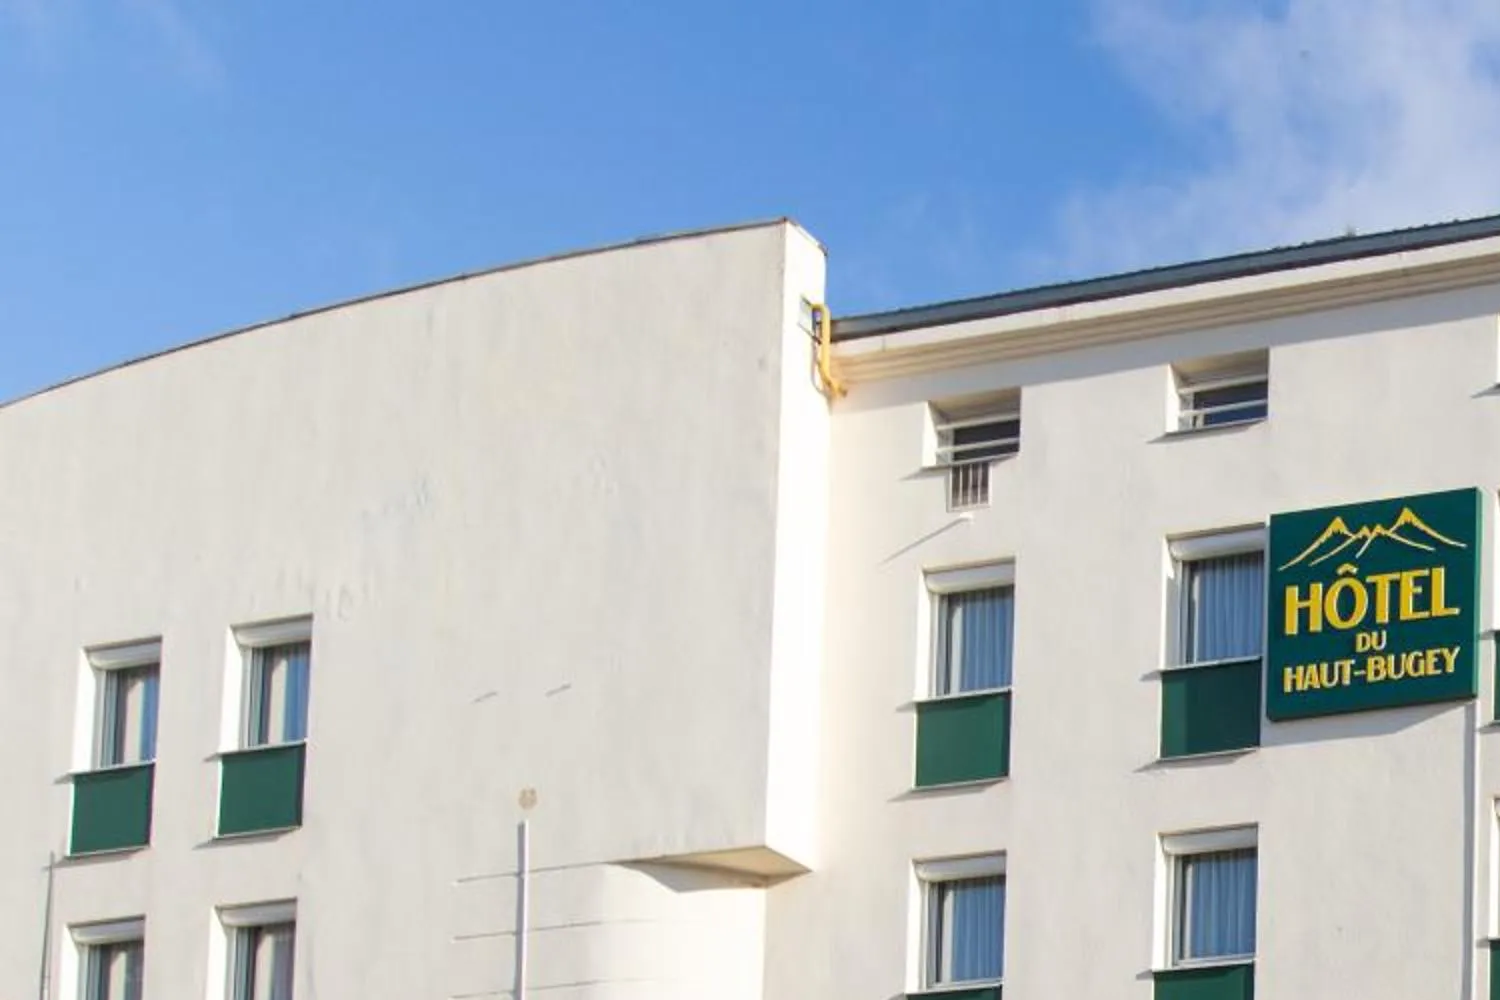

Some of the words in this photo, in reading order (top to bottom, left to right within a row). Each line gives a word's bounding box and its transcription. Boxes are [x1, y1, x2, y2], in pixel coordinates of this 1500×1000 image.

[1284, 563, 1461, 635] HÔTEL
[1355, 630, 1387, 653] DU
[1283, 646, 1461, 693] HAUT-BUGEY
